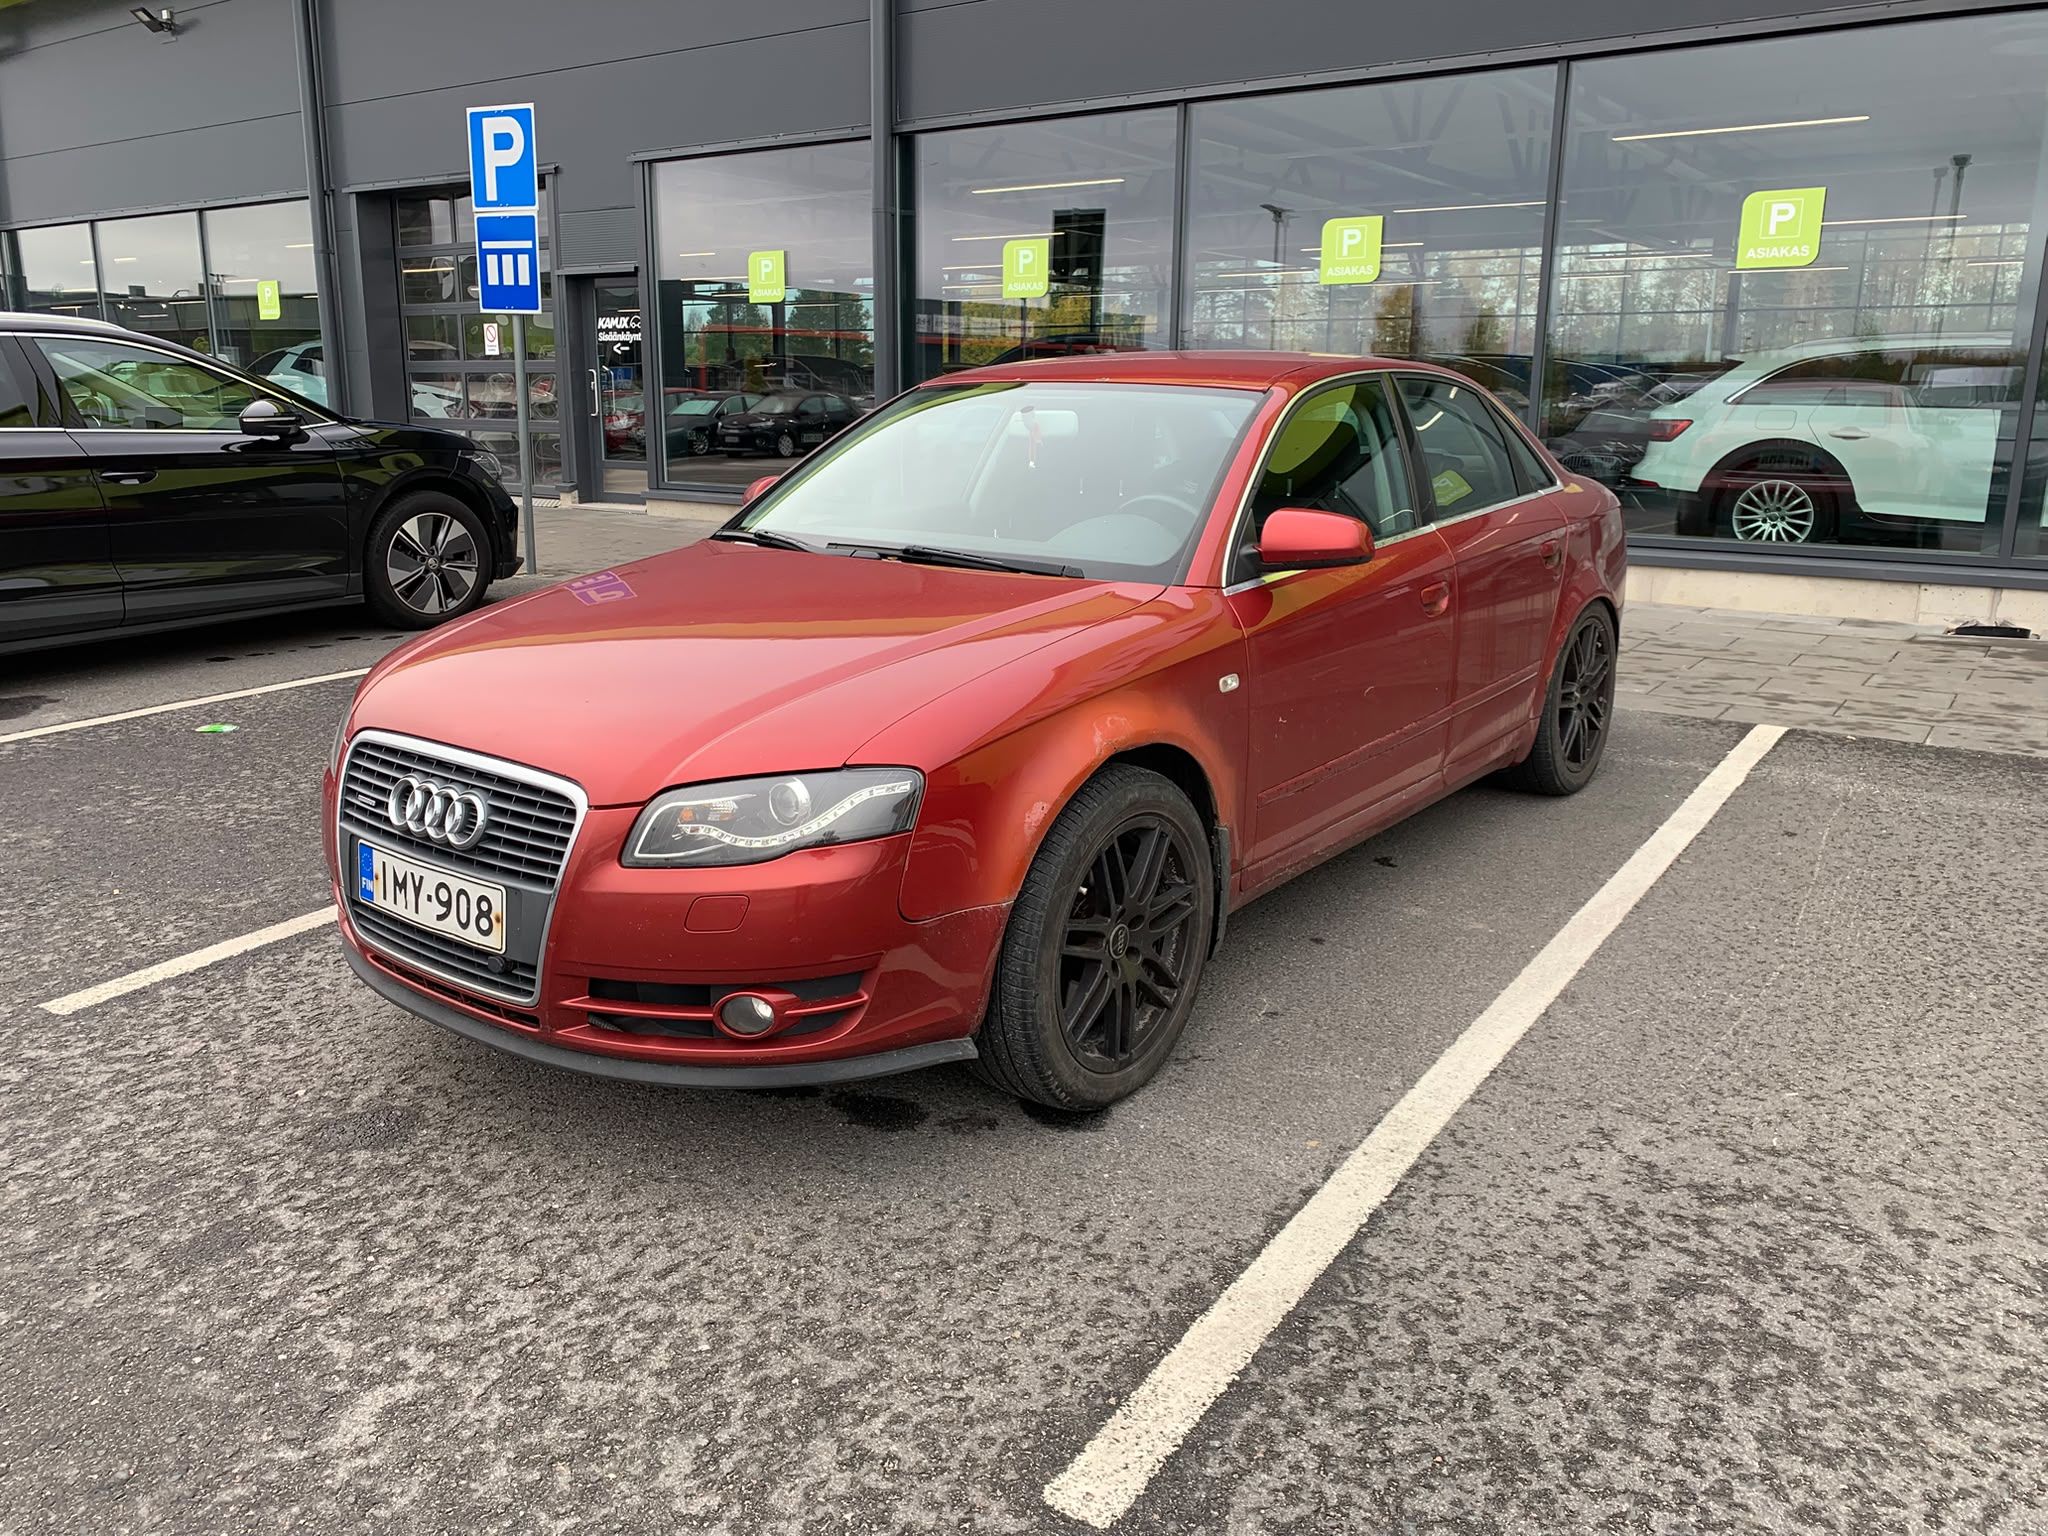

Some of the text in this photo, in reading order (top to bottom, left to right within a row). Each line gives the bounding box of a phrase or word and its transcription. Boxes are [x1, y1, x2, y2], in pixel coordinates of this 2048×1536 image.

[482, 116, 525, 202] P
[1768, 203, 1796, 235] P
[1342, 228, 1361, 257] P
[1745, 244, 1810, 259] ASIAKAS
[760, 259, 773, 281] P
[1018, 249, 1033, 274] P
[1327, 264, 1374, 276] ASIAKAS
[264, 287, 272, 304] P
[1007, 281, 1044, 291] ASIAKAS
[598, 316, 629, 329] KAMUX
[361, 876, 374, 893] FIN
[382, 861, 494, 937] IMY-908
